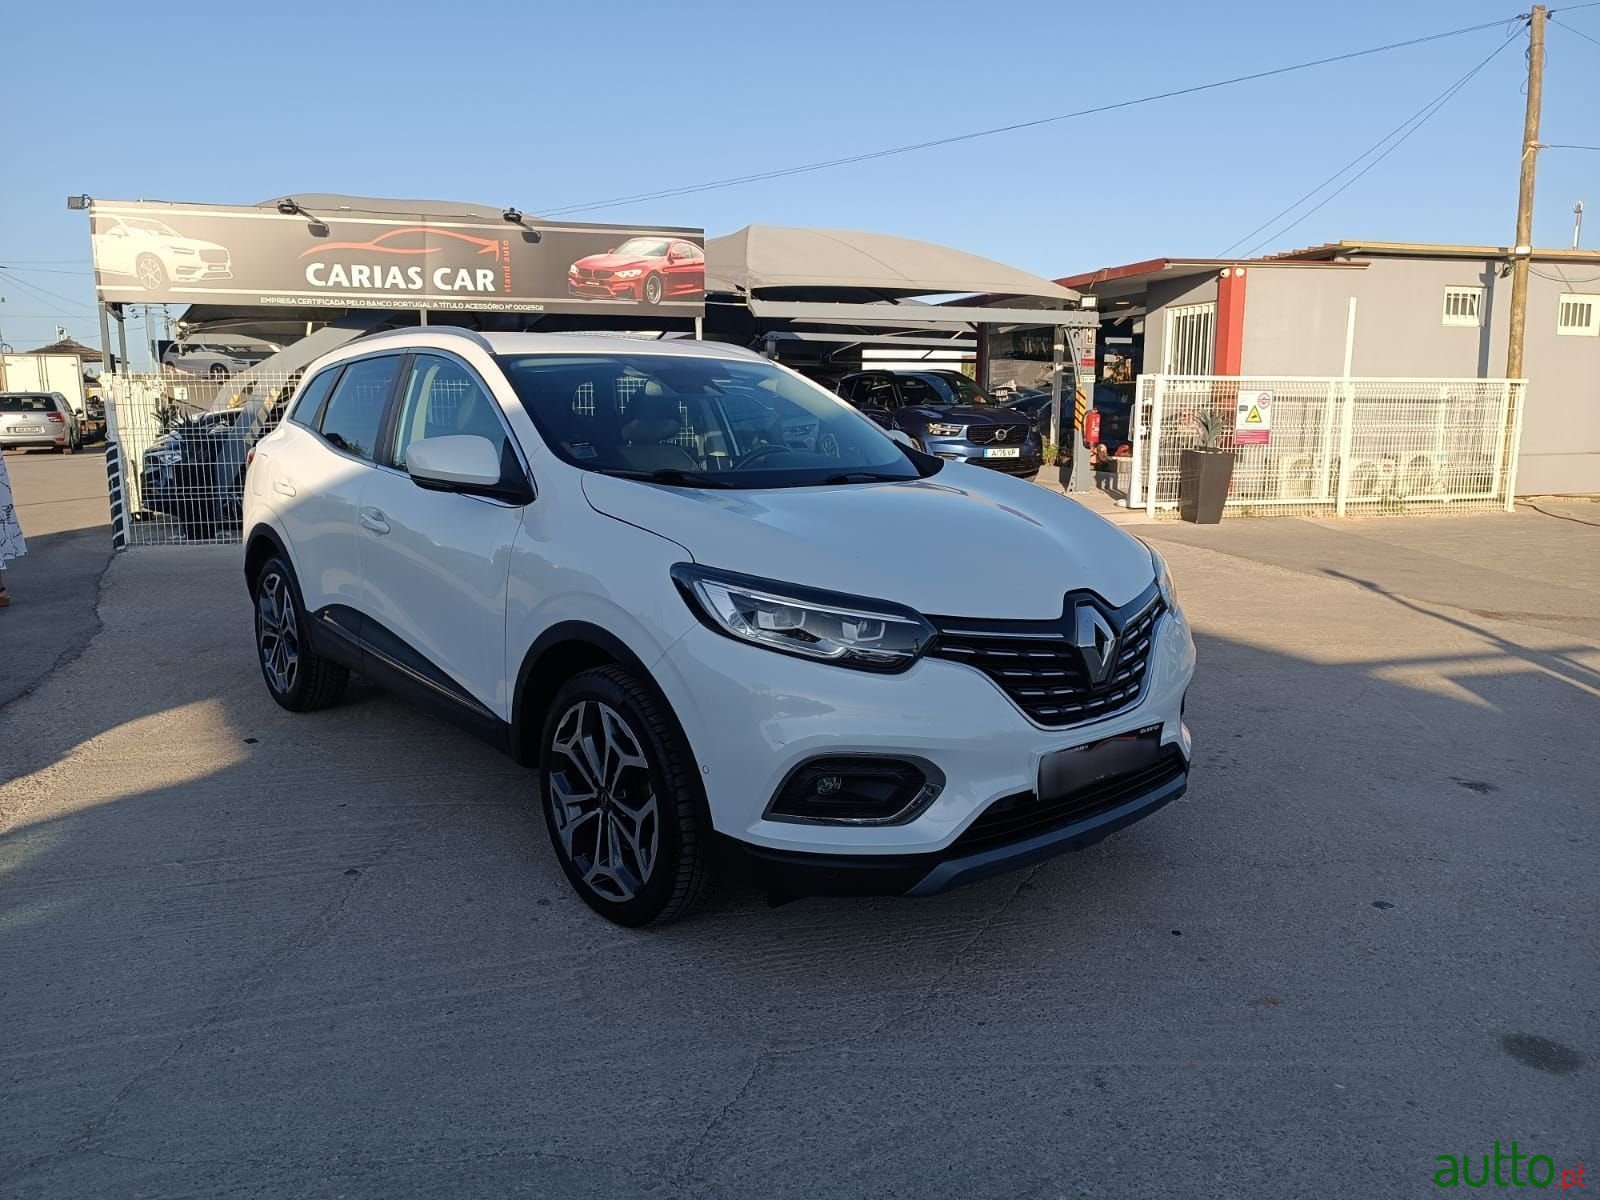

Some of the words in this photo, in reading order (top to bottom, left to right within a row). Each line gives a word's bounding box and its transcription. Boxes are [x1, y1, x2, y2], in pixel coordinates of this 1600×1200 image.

[502, 240, 510, 262] auto
[306, 262, 424, 291] CARIAS
[432, 266, 496, 292] CAR
[502, 266, 512, 293] stand
[260, 296, 297, 305] EMPRESA
[297, 297, 346, 307] CERTIFICADA
[347, 299, 365, 307] PELO
[366, 300, 392, 308] BANCO
[393, 300, 432, 309] PORTUGAL
